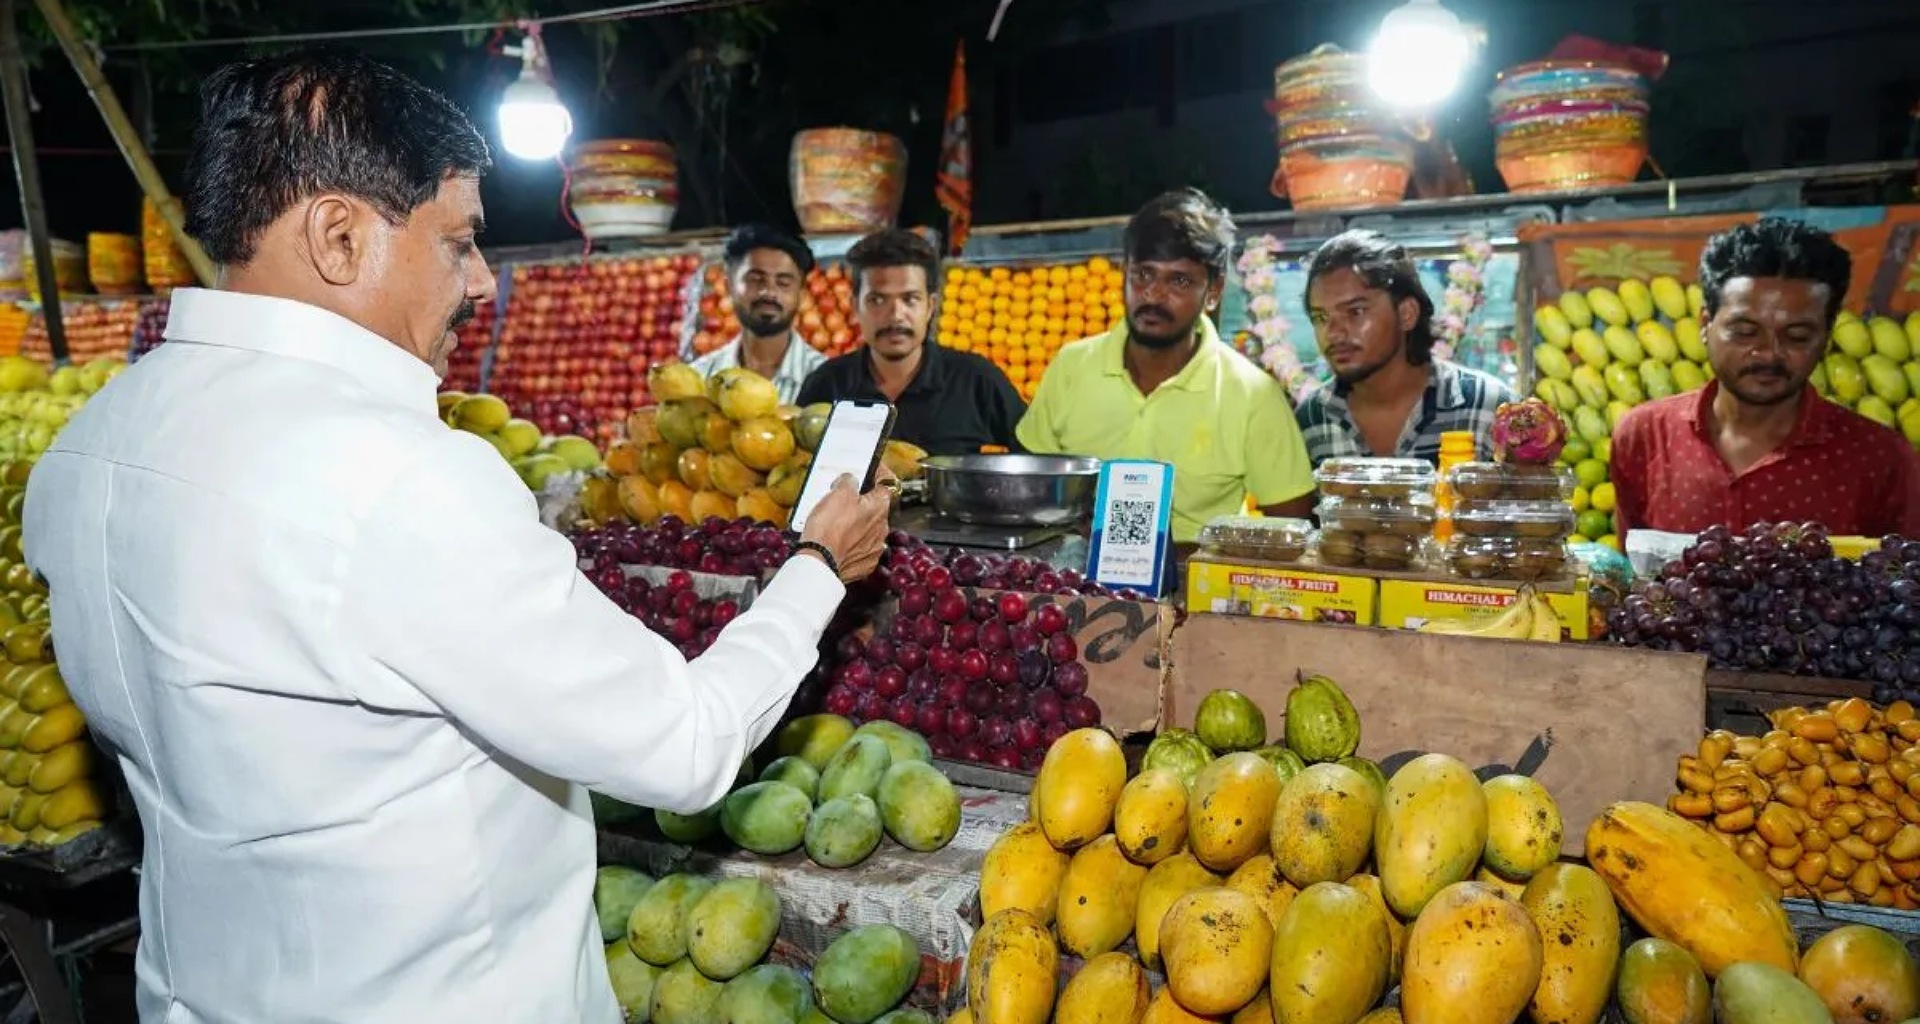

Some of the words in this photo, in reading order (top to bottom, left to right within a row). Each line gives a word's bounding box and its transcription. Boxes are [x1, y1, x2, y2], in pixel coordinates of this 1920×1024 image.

[1232, 573, 1295, 588] HIMACHAL
[1298, 580, 1336, 592] FRUIT
[1428, 590, 1500, 605] HIMACHAL
